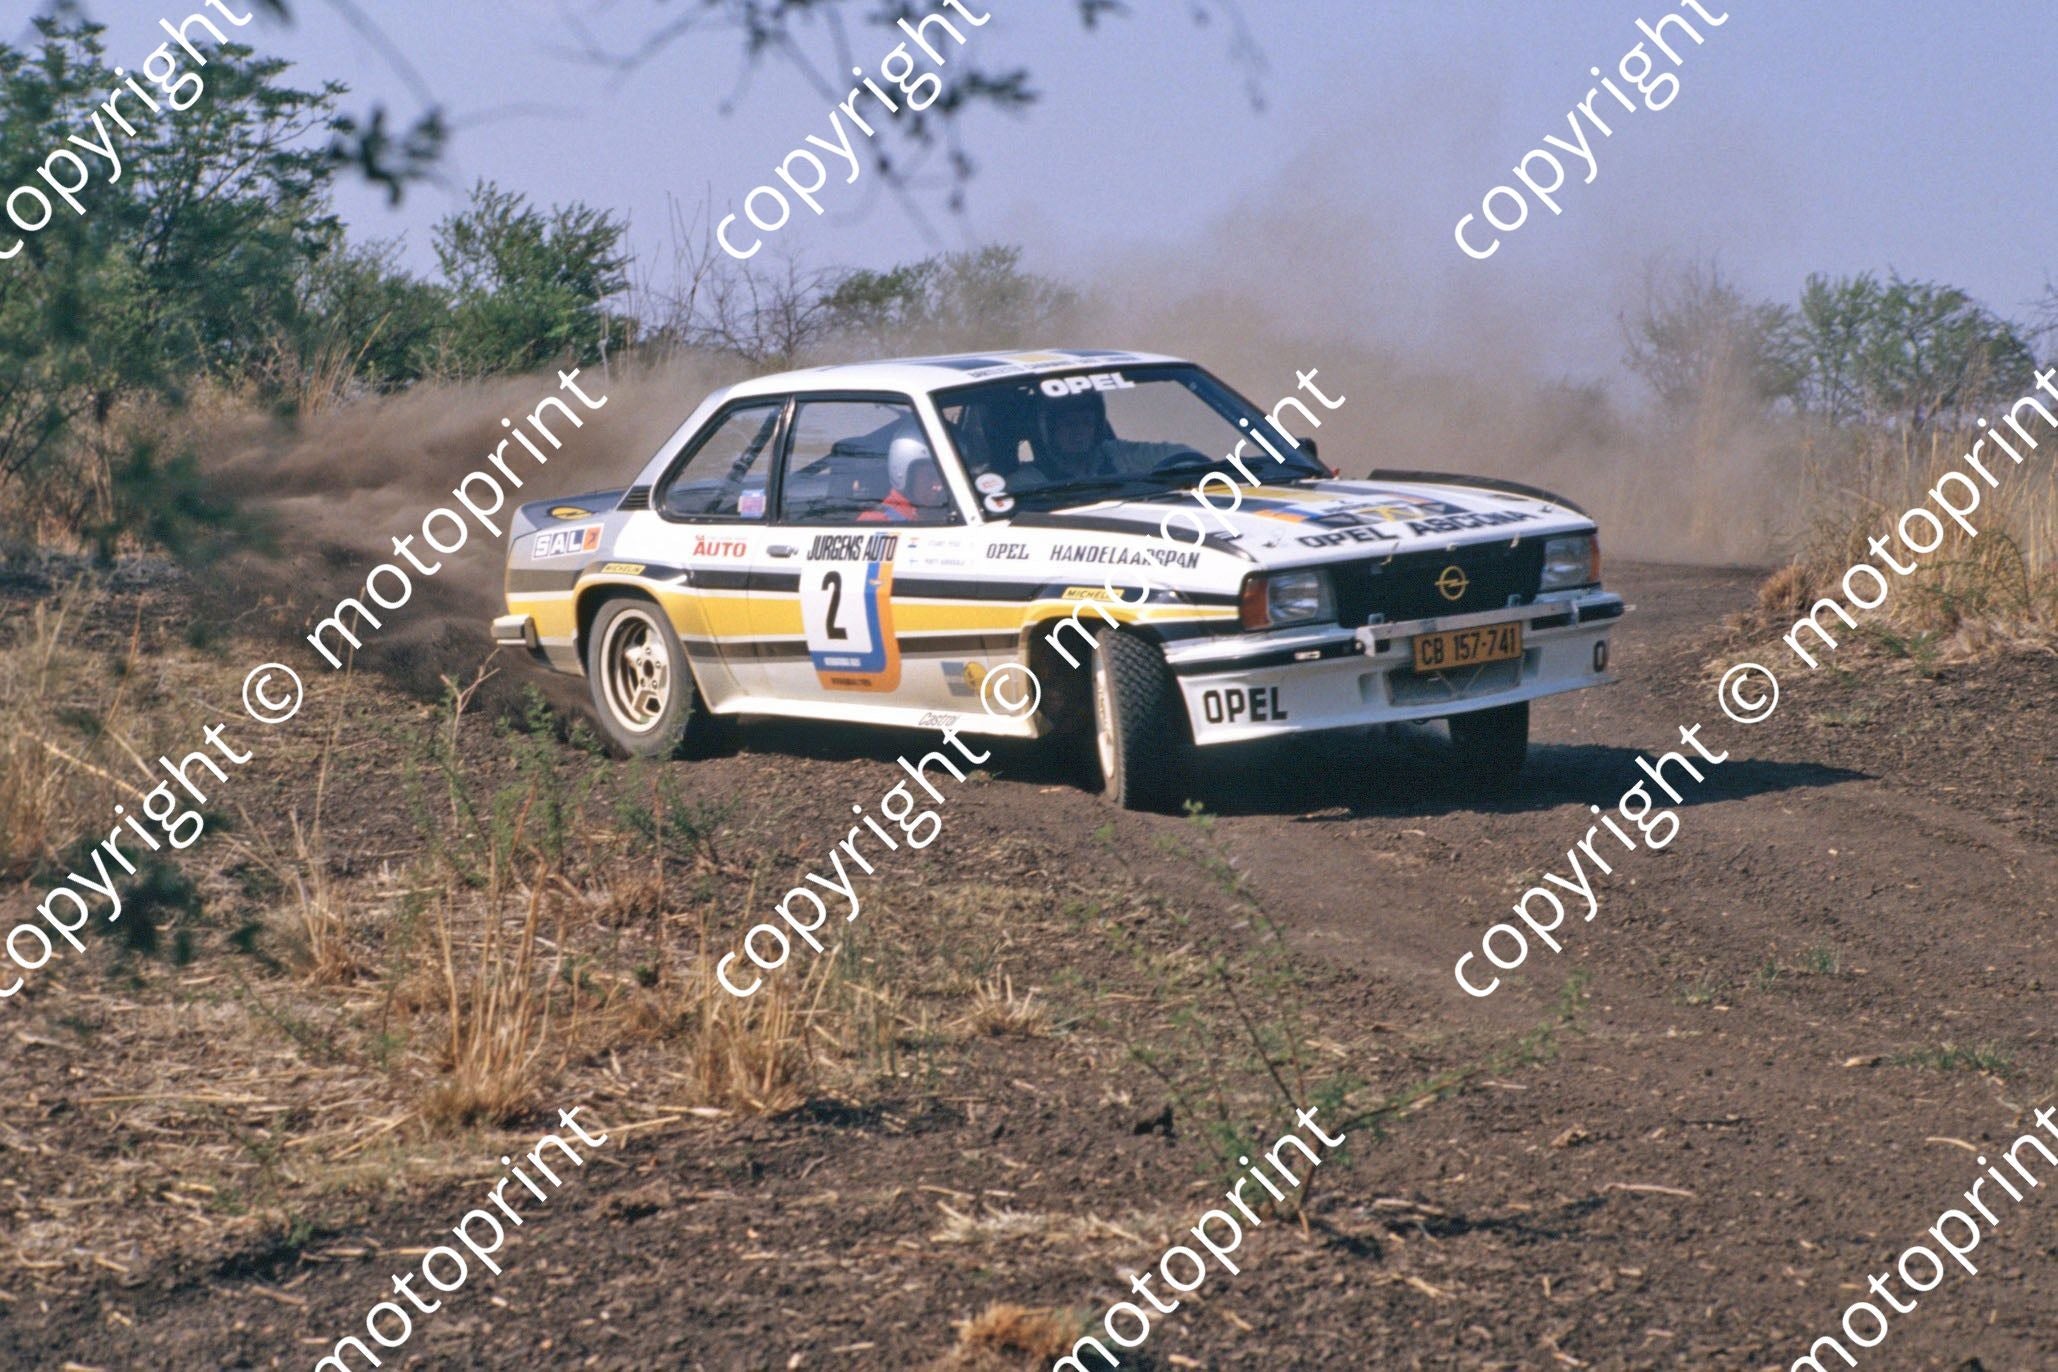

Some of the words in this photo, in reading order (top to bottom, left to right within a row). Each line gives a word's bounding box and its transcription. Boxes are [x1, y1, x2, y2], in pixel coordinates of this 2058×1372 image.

[1040, 371, 1136, 398] OPEL
[534, 530, 581, 558] SAL
[692, 541, 747, 558] AUTO
[806, 535, 865, 562] JURGENS
[862, 535, 899, 562] AUTO
[1297, 527, 1398, 548] OPEL
[986, 543, 1030, 560] OPEL
[821, 571, 848, 640] 2
[1066, 589, 1121, 600] MICHEL
[1421, 638, 1445, 666] CB
[1453, 627, 1516, 662] 157-741
[1202, 686, 1289, 725] OPEL
